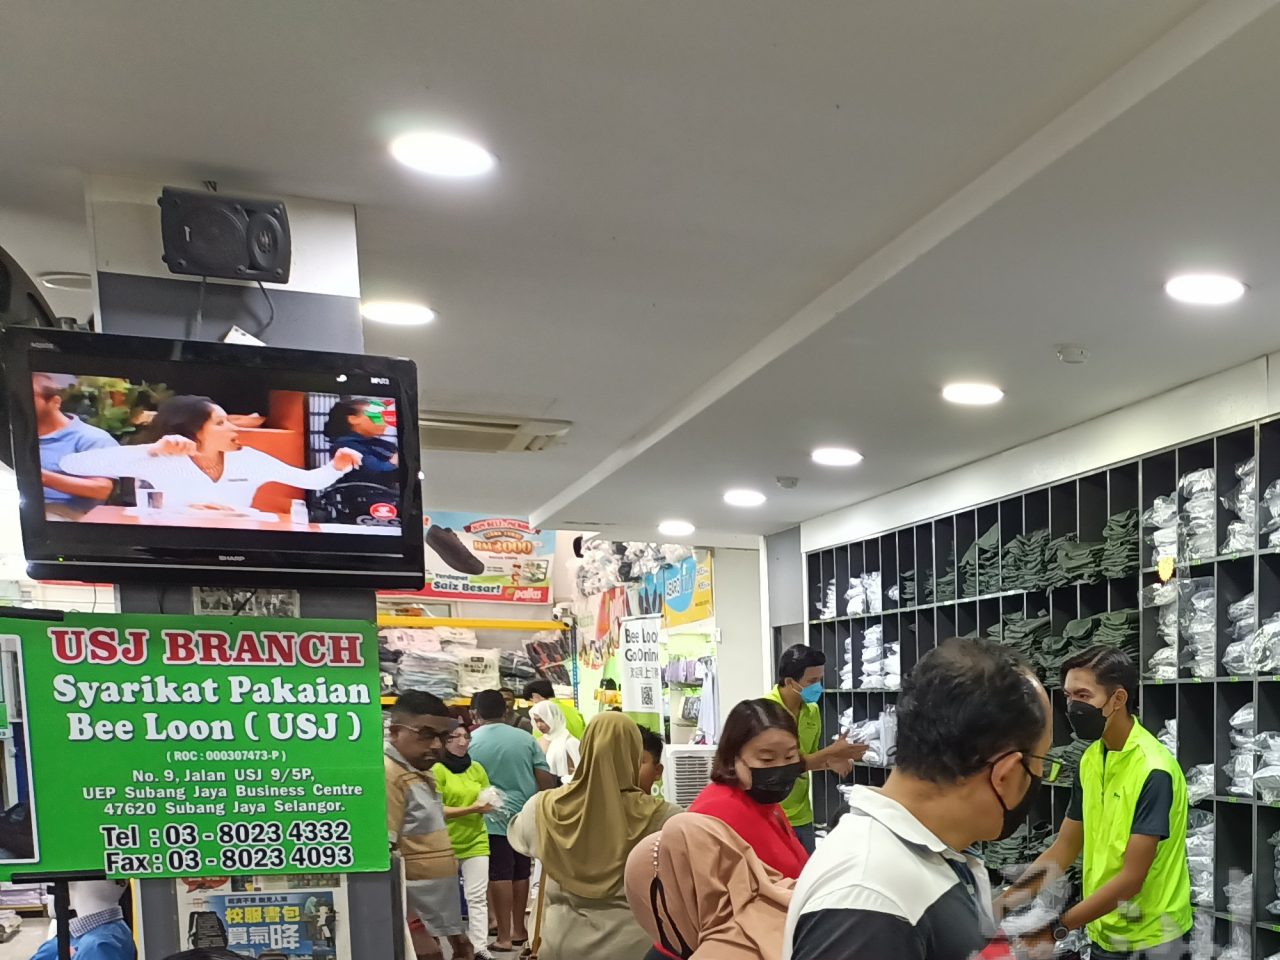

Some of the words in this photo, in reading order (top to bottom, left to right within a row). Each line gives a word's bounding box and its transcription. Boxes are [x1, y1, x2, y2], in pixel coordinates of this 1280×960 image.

[433, 581, 459, 591] Saiz
[461, 582, 501, 593] Besar!
[513, 588, 542, 600] pallas
[625, 628, 640, 644] Bee
[49, 627, 149, 664] USJ
[162, 630, 365, 667] BRANCH
[54, 675, 219, 709] Syarikat
[230, 677, 370, 704] Pakaian
[69, 713, 134, 741] Bee
[145, 714, 234, 741] Loon
[269, 714, 337, 740] USJ
[206, 751, 278, 761] 000307473-P
[133, 770, 159, 783] No.
[184, 769, 226, 782] Jalan
[234, 769, 263, 781] USJ
[271, 768, 315, 783] 9/5P,
[83, 787, 116, 800] UEP
[125, 786, 186, 801] Subang
[194, 787, 227, 800] Jaya
[236, 785, 305, 797] Business
[313, 783, 363, 796] Centre
[104, 803, 157, 816] 47620
[166, 802, 226, 817] Subang
[233, 802, 266, 815] Jaya
[274, 800, 345, 815] Selangor.
[100, 826, 139, 849] Tel
[164, 824, 199, 846] 03
[217, 822, 283, 845] 8023
[287, 820, 351, 843] 4332
[104, 850, 151, 873] Fax
[167, 849, 201, 872] 03
[219, 847, 286, 870] 8023
[289, 845, 353, 867] 4093
[225, 906, 301, 924] 校服書包
